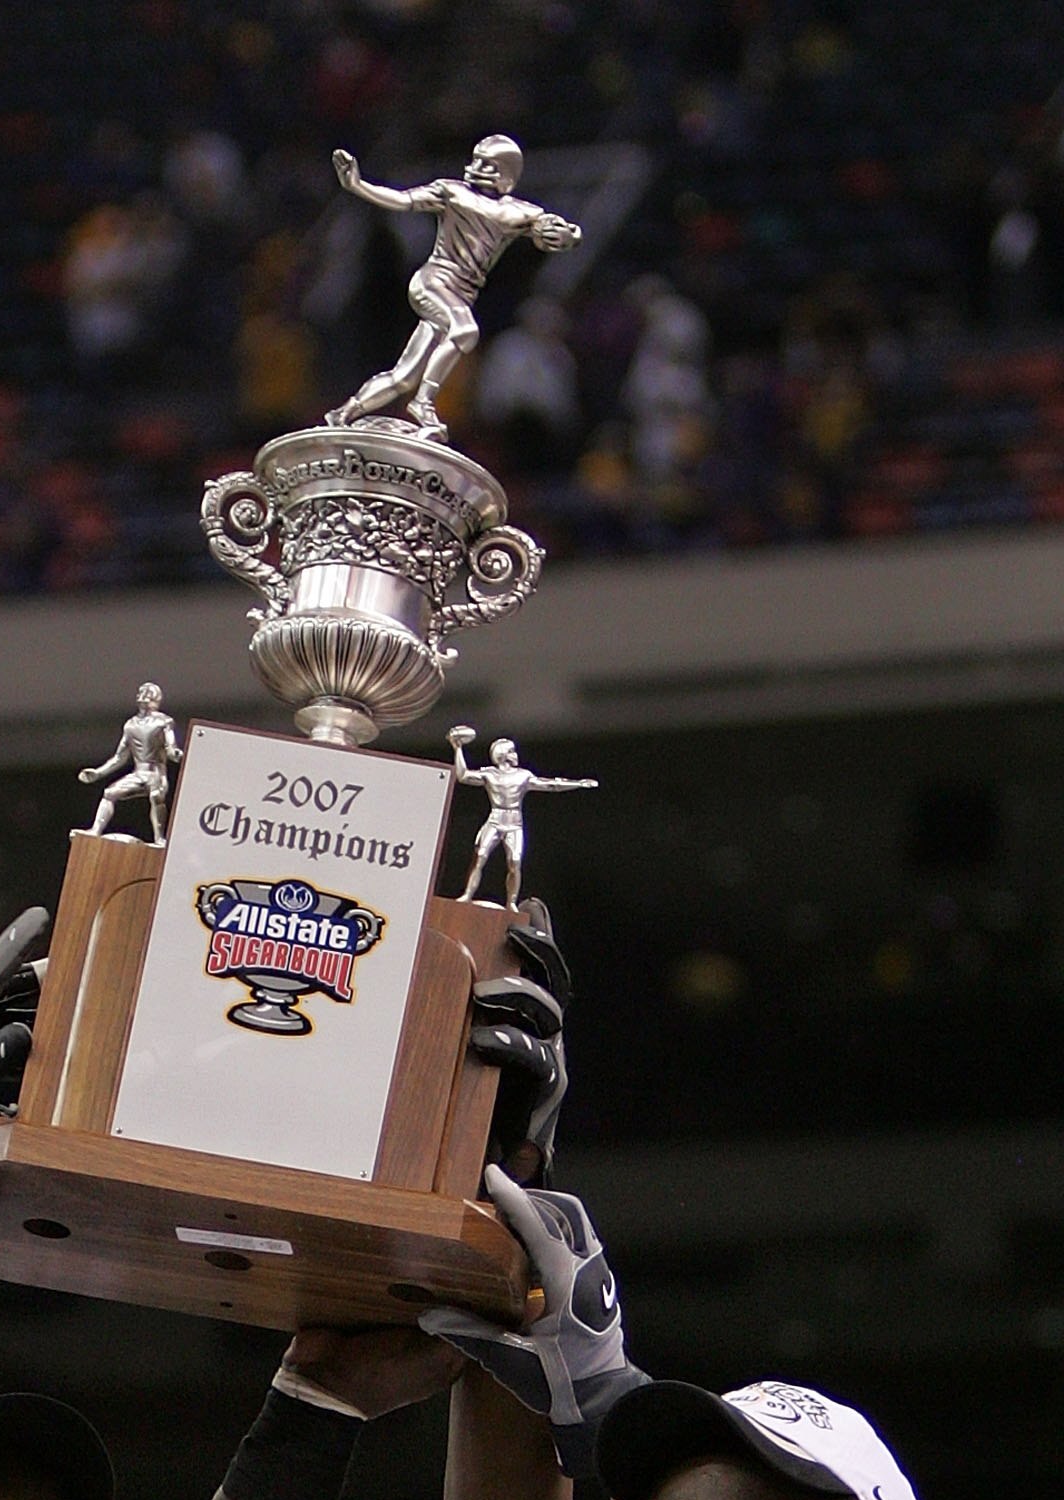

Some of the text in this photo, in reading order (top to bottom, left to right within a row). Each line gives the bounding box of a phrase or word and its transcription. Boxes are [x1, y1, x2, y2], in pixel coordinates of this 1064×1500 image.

[262, 771, 364, 816] 2007
[198, 802, 414, 870] Champions
[217, 903, 351, 949] Allstate
